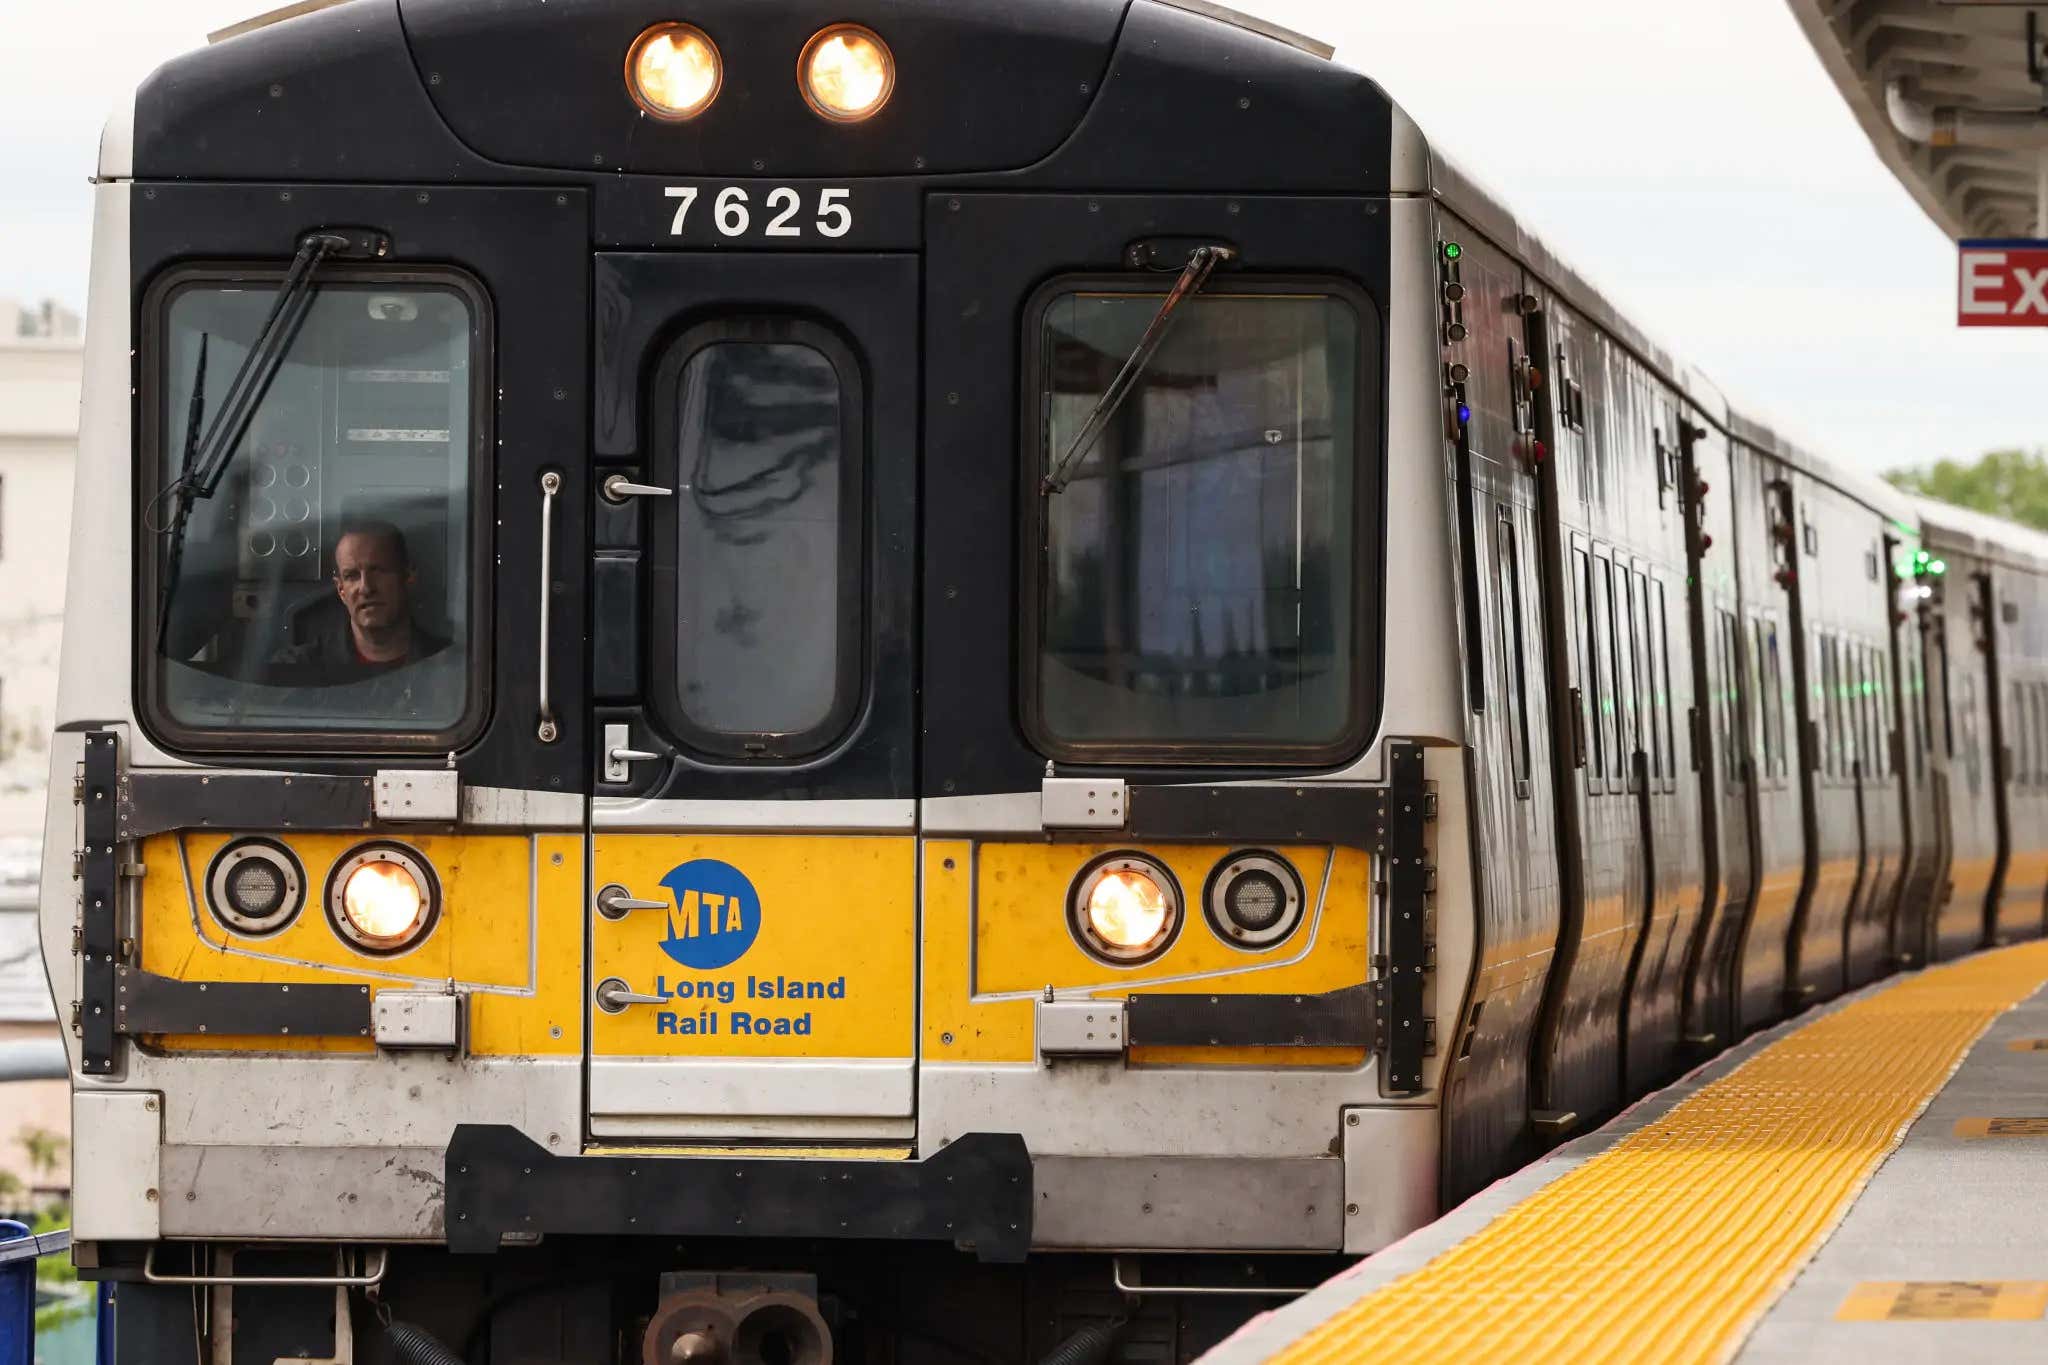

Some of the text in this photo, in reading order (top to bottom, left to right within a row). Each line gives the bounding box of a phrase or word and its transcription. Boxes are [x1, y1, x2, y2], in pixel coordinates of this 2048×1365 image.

[664, 186, 852, 237] 7625
[1962, 253, 2048, 313] Ex
[658, 885, 743, 941] MTA
[657, 975, 845, 1003] Long Island
[656, 1011, 812, 1036] Rail Road
